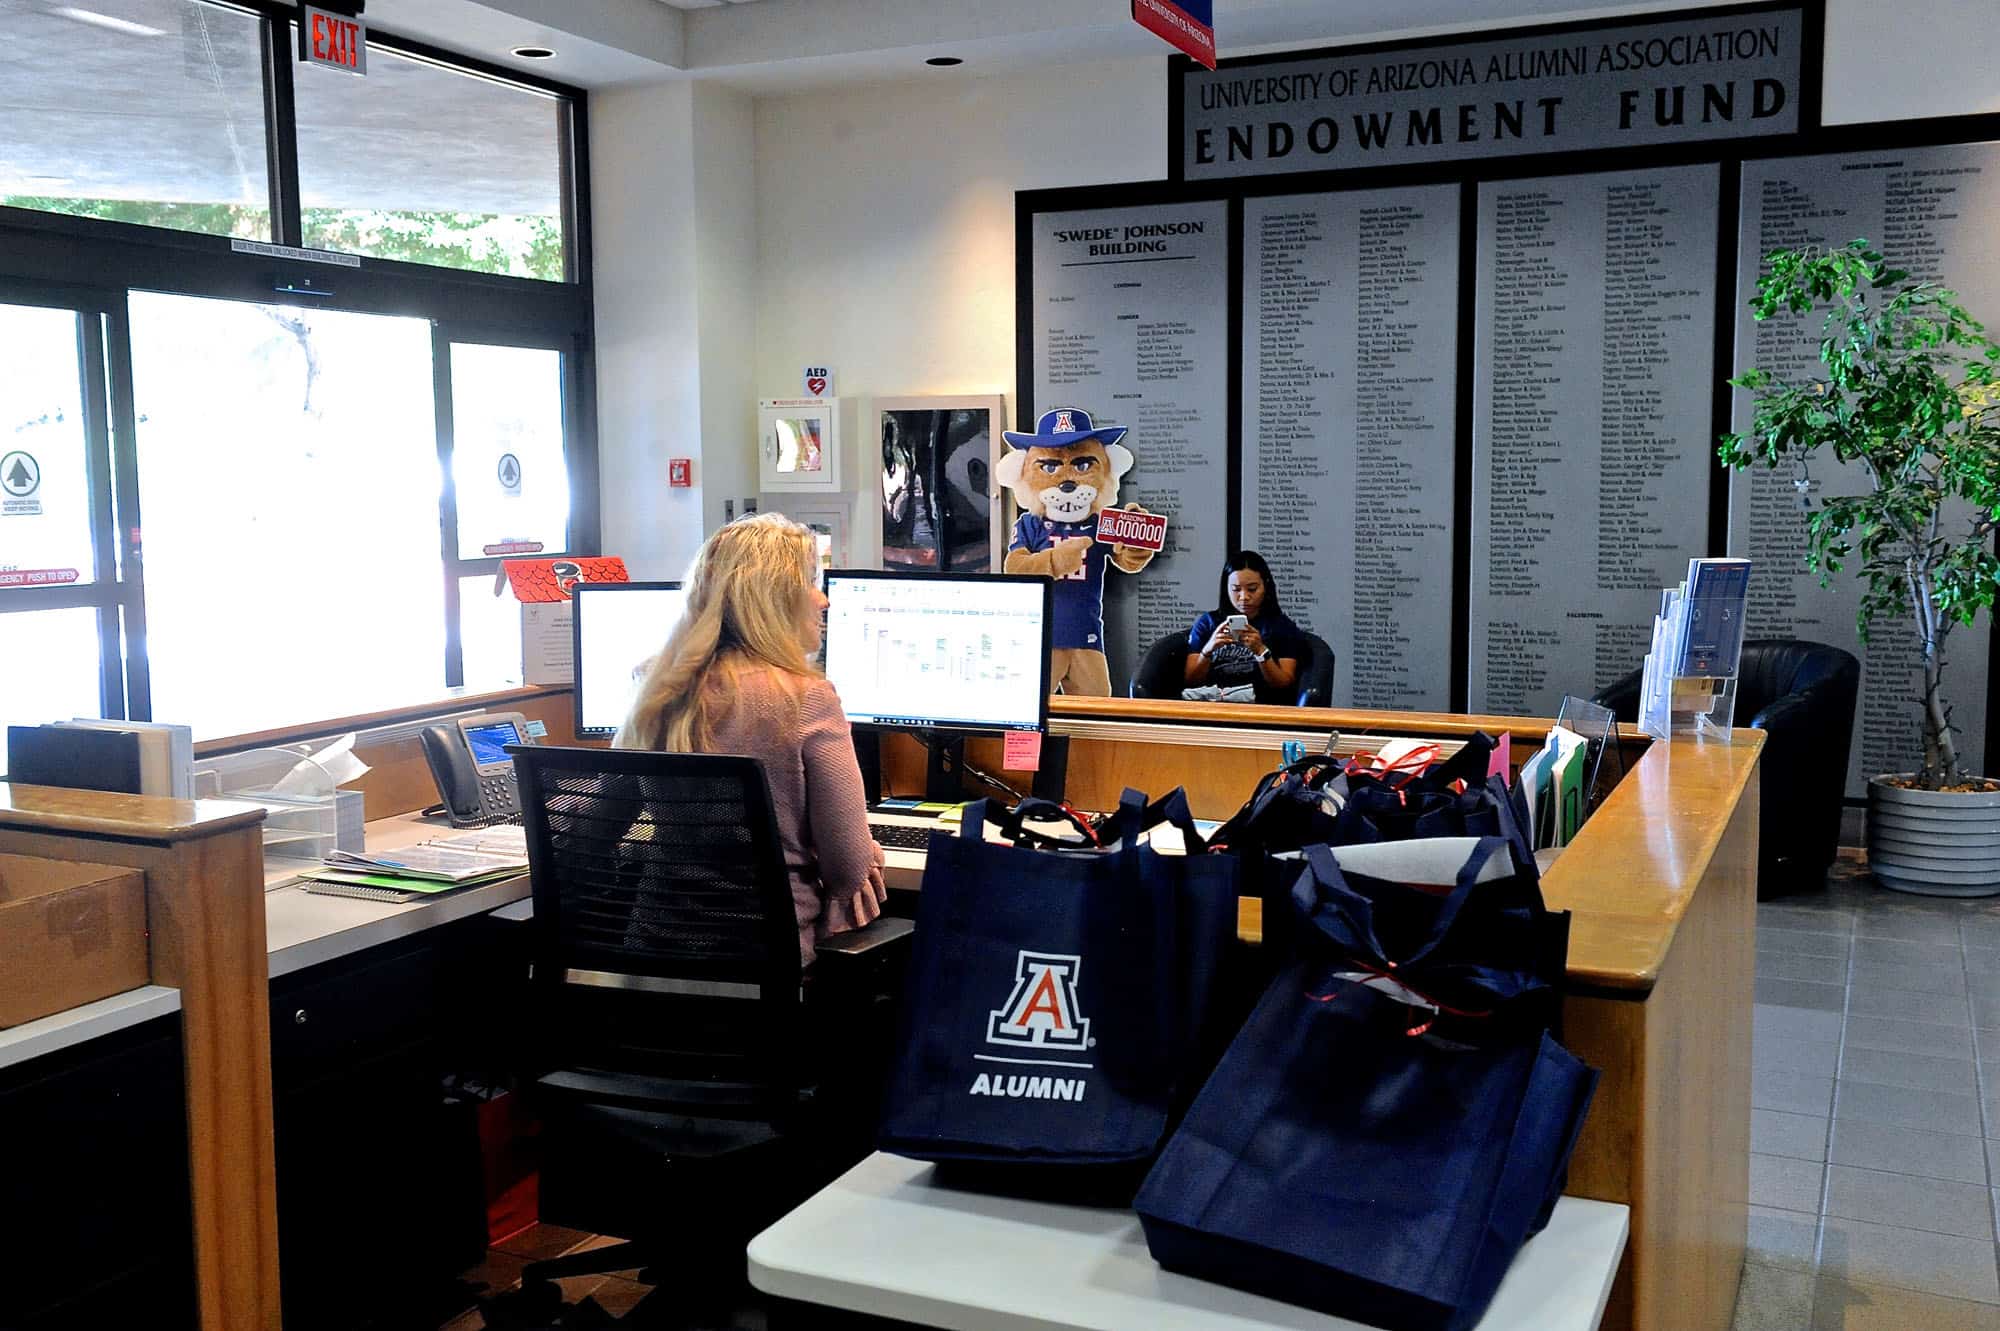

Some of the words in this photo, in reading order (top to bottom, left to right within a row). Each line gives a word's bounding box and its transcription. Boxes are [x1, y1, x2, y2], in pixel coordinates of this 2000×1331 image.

[312, 13, 359, 68] EXIT
[1200, 73, 1323, 111] UNIVERSITY
[1328, 69, 1358, 97] OF
[1365, 57, 1476, 95] ARIZONA
[1485, 46, 1587, 83] ALUMNI
[1596, 27, 1780, 73] ASSOCIATION
[1195, 96, 1563, 165] ENDOWMENT
[1619, 78, 1787, 139] FUND
[1053, 227, 1119, 243] "SWEDE"
[1124, 221, 1204, 241] JOHNSON
[1089, 239, 1167, 257] BUILDING
[806, 368, 827, 377] AED
[1053, 411, 1076, 434] A
[1118, 513, 1147, 522] ARIZONA
[1116, 521, 1162, 543] 000000
[986, 950, 1090, 1050] A
[969, 1073, 1086, 1102] ALUMNI
